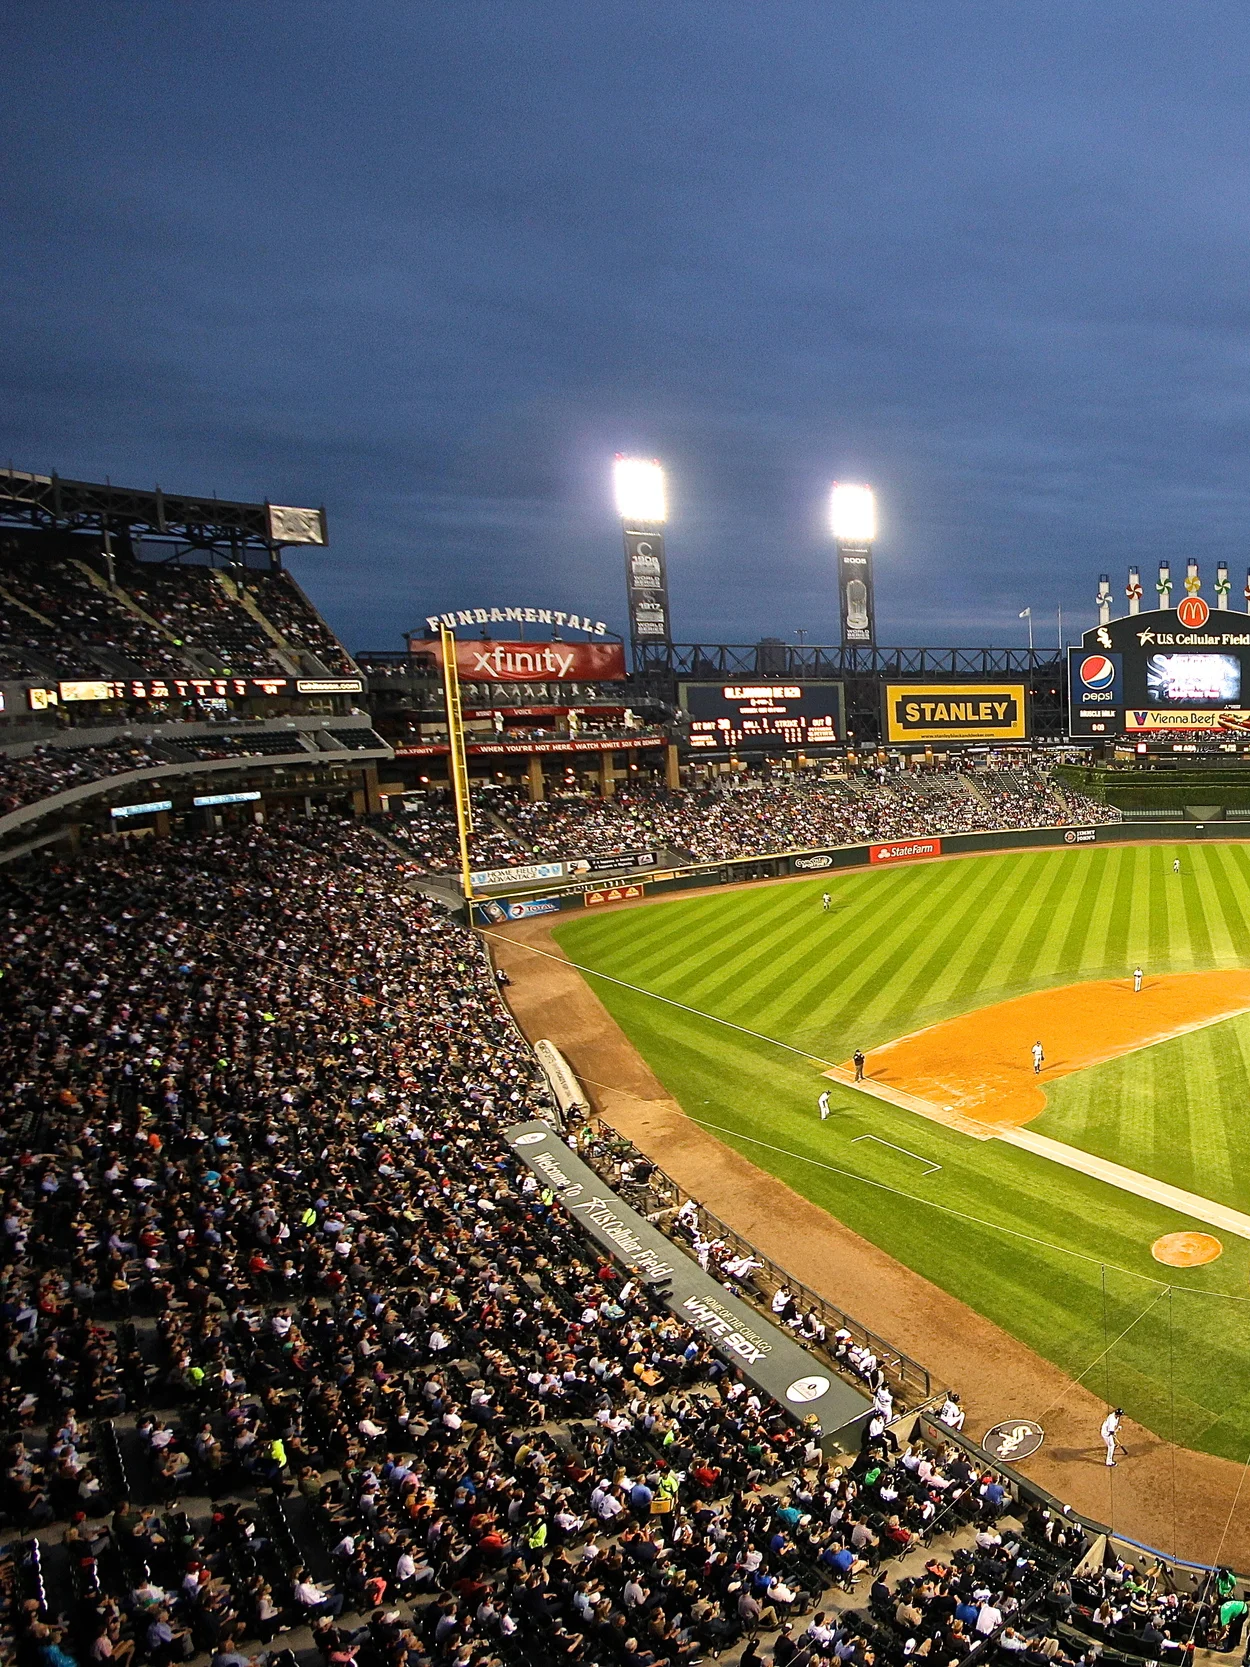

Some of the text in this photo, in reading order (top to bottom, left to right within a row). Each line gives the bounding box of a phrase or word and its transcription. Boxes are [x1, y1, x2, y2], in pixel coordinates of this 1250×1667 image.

[426, 607, 607, 636] FUNDAMENTALS
[1175, 633, 1221, 645] Cellular
[1222, 633, 1250, 645] Field
[473, 646, 574, 678] xfinity
[1082, 691, 1113, 702] pepsi
[905, 702, 1008, 722] STANLEY
[1151, 713, 1189, 723] Vienna
[1190, 713, 1215, 726] Beef
[774, 720, 798, 728] STRIKE
[553, 743, 573, 751] HERE,
[488, 873, 536, 883] ADVANTAGE
[526, 904, 553, 912] TOTAL
[532, 1152, 584, 1197] Welcome To
[602, 1221, 642, 1253] Cellular
[631, 1249, 674, 1279] Field
[683, 1295, 767, 1365] WHITE SOX
[702, 1295, 772, 1353] HOME OF THE CHICAGO
